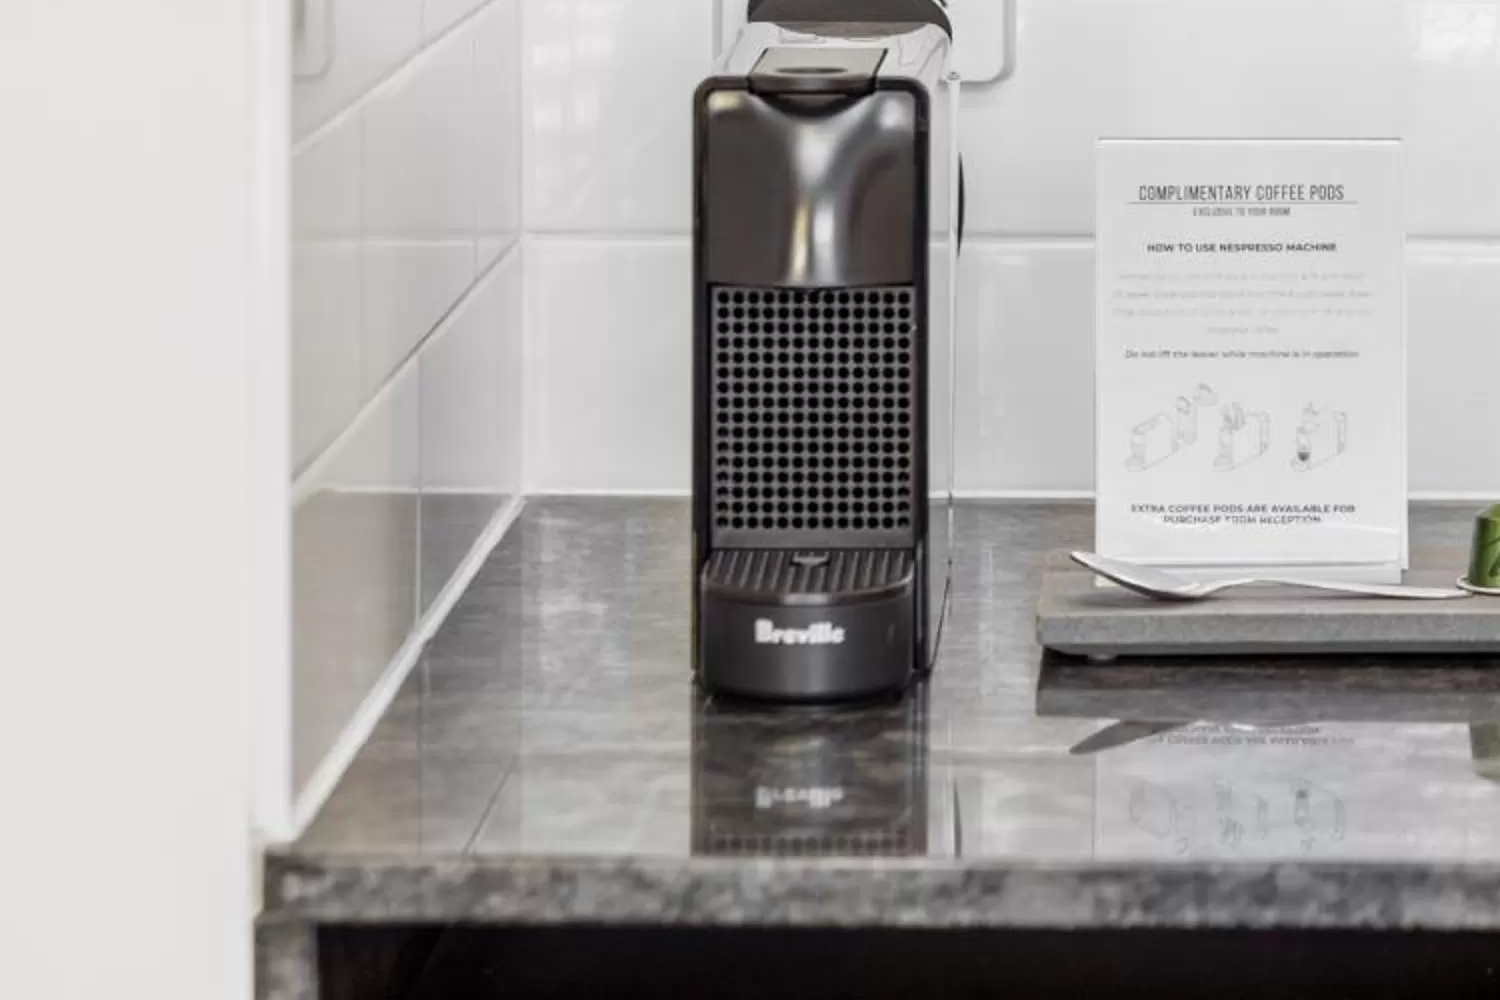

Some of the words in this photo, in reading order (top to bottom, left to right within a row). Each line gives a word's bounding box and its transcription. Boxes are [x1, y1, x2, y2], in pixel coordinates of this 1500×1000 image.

[1138, 184, 1251, 201] COMPLIMENTARY
[1256, 184, 1305, 201] COFFEE
[1309, 184, 1345, 201] PODS
[1147, 243, 1175, 253] HOW
[1178, 243, 1193, 253] TO
[1195, 243, 1216, 253] USE
[1219, 243, 1283, 253] NESPRESSO
[1286, 243, 1337, 253] MACHINE
[1130, 503, 1165, 513] EXTRA
[1167, 503, 1210, 513] COFFEE
[1213, 503, 1244, 513] PODS
[1246, 503, 1268, 513] ARE
[1271, 503, 1330, 513] AVAILABLE
[1333, 503, 1356, 513] FOR
[1162, 514, 1222, 525] PURCHASE
[1259, 513, 1322, 525] RECEPTION
[754, 617, 846, 645] Breville
